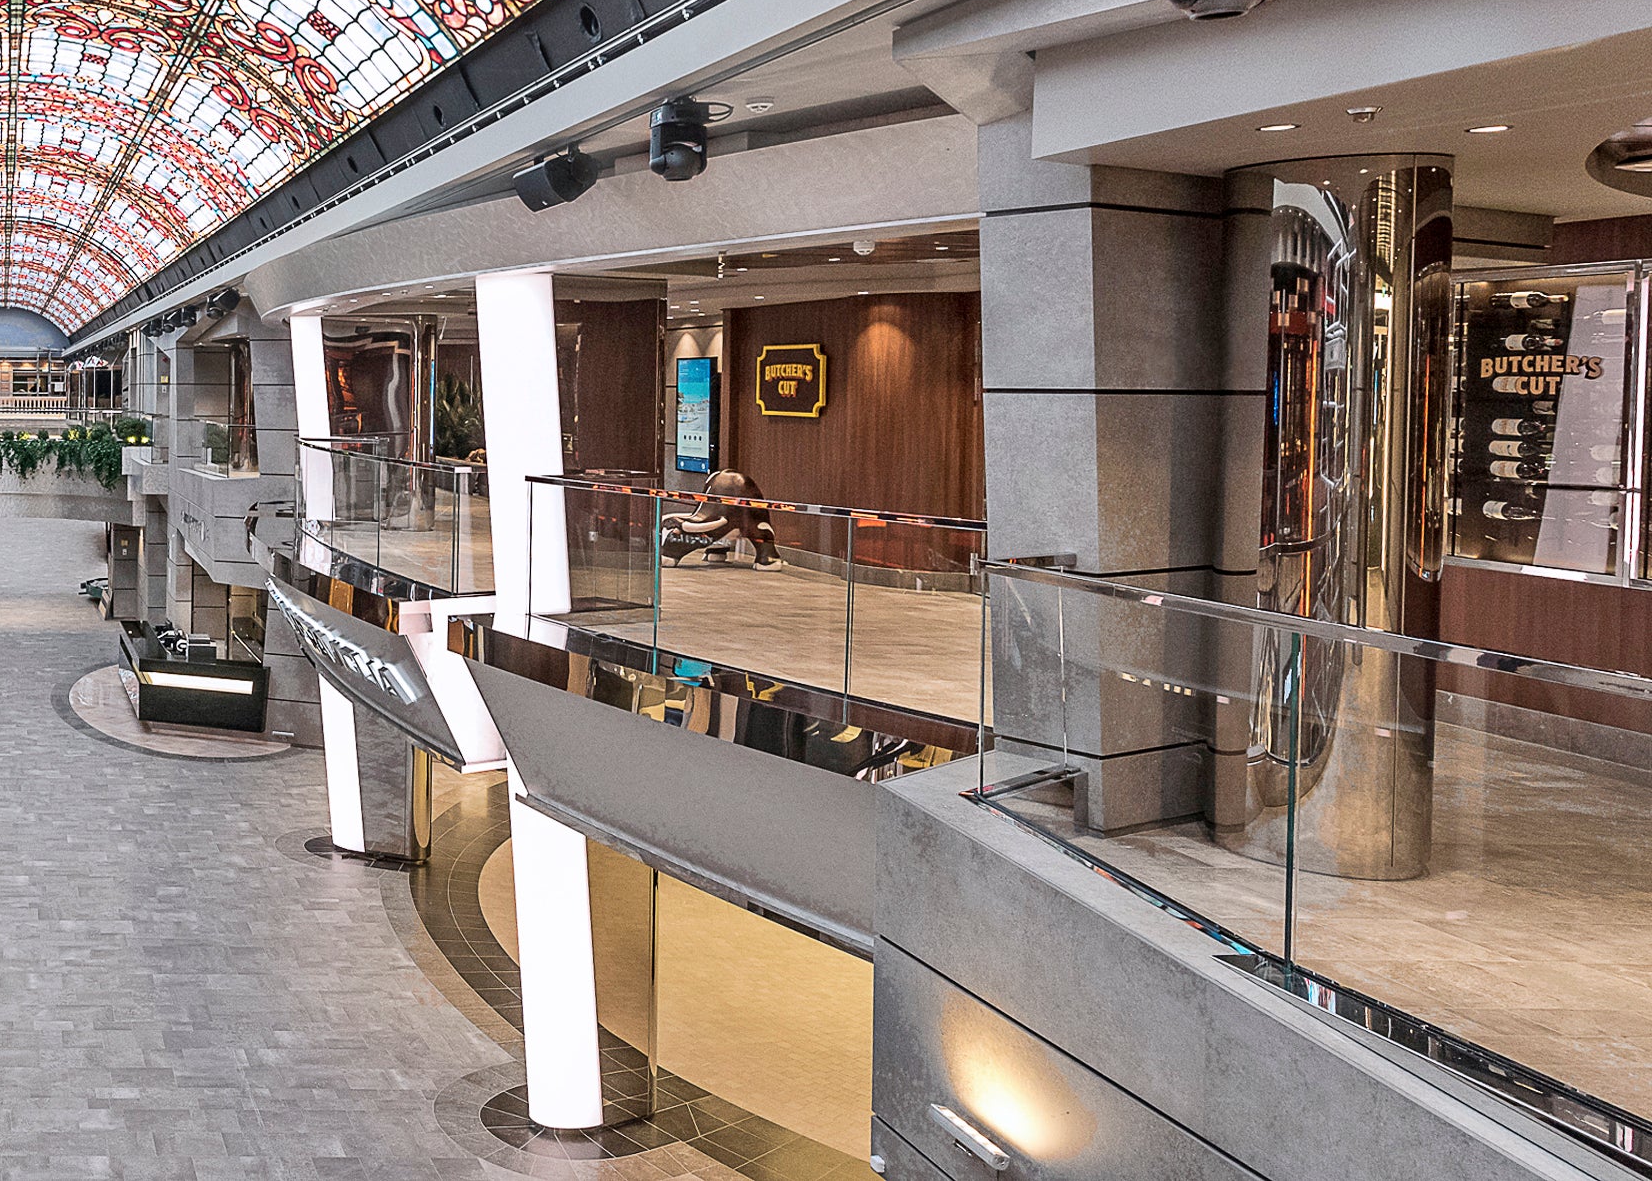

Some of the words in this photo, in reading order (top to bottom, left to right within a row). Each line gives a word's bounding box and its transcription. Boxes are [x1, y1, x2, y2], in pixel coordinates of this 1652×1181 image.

[765, 363, 813, 383] BUTCHER'S
[1480, 355, 1603, 379] BUTCHER'S
[778, 381, 798, 398] CUT
[1515, 376, 1560, 395] CUT
